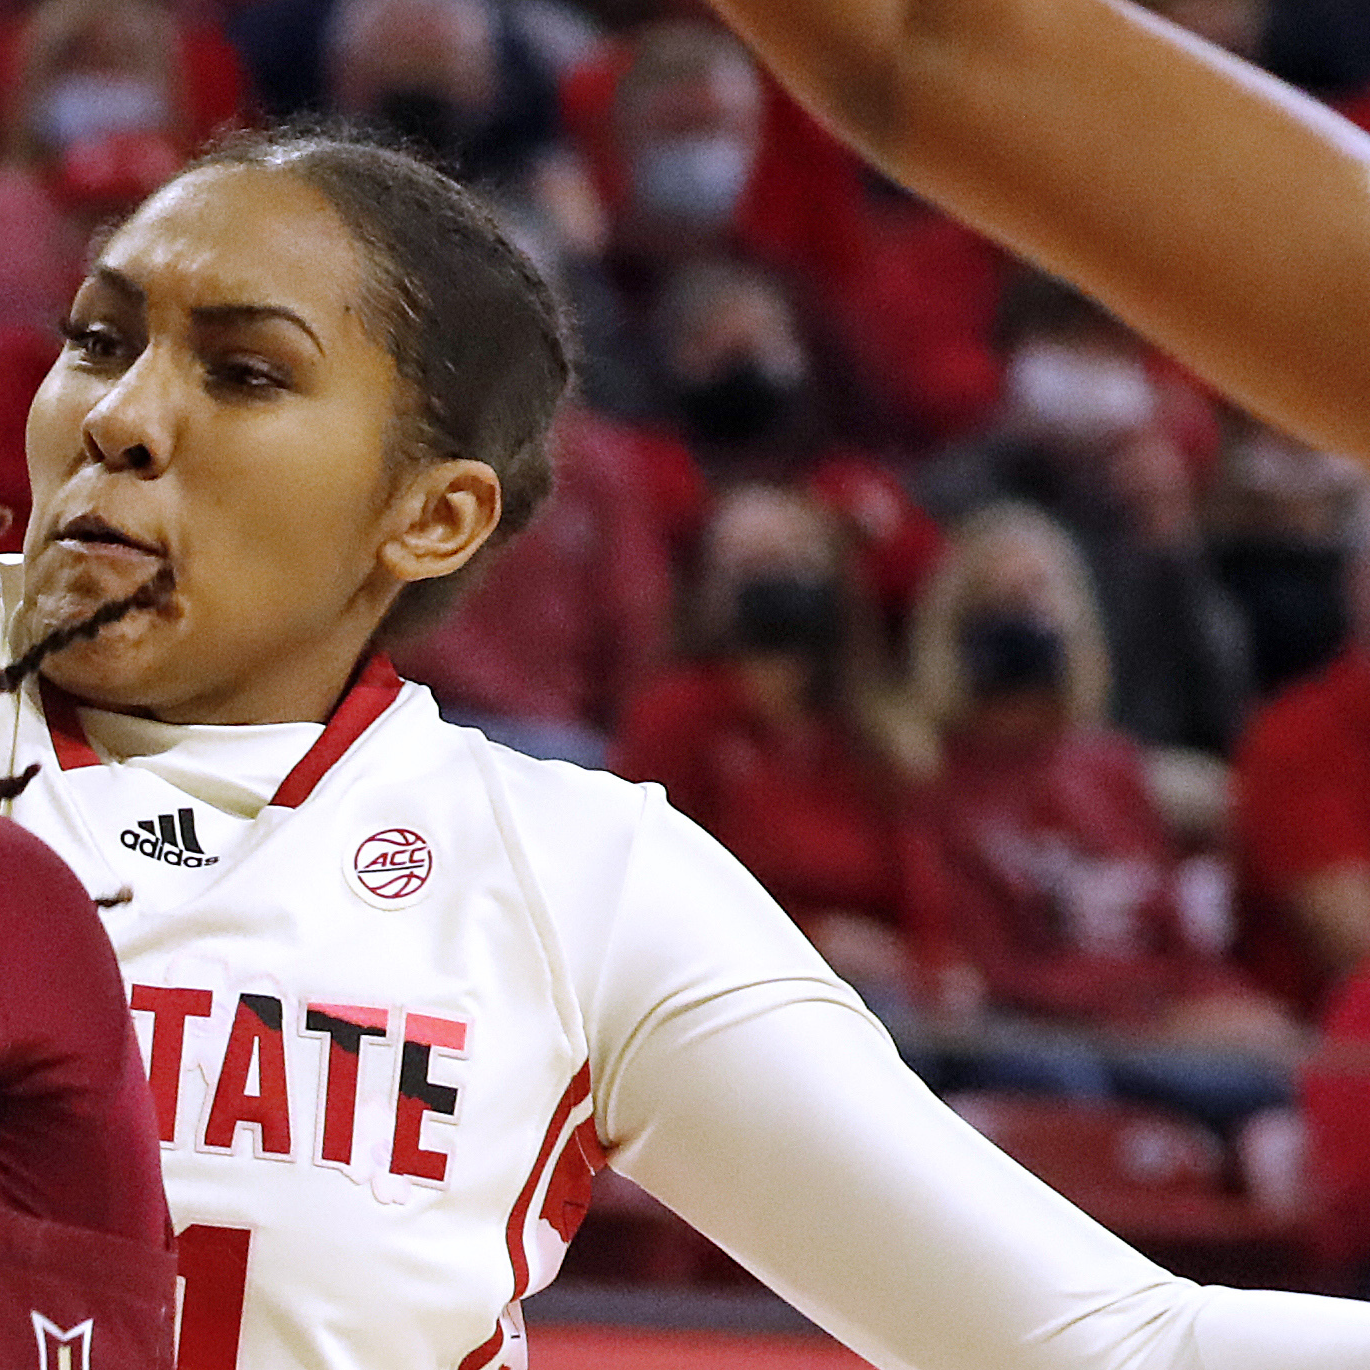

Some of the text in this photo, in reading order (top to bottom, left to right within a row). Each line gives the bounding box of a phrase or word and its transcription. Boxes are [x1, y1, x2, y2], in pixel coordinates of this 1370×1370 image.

[119, 828, 220, 868] adidas
[363, 846, 427, 869] ACC
[131, 983, 468, 1179] TATE
